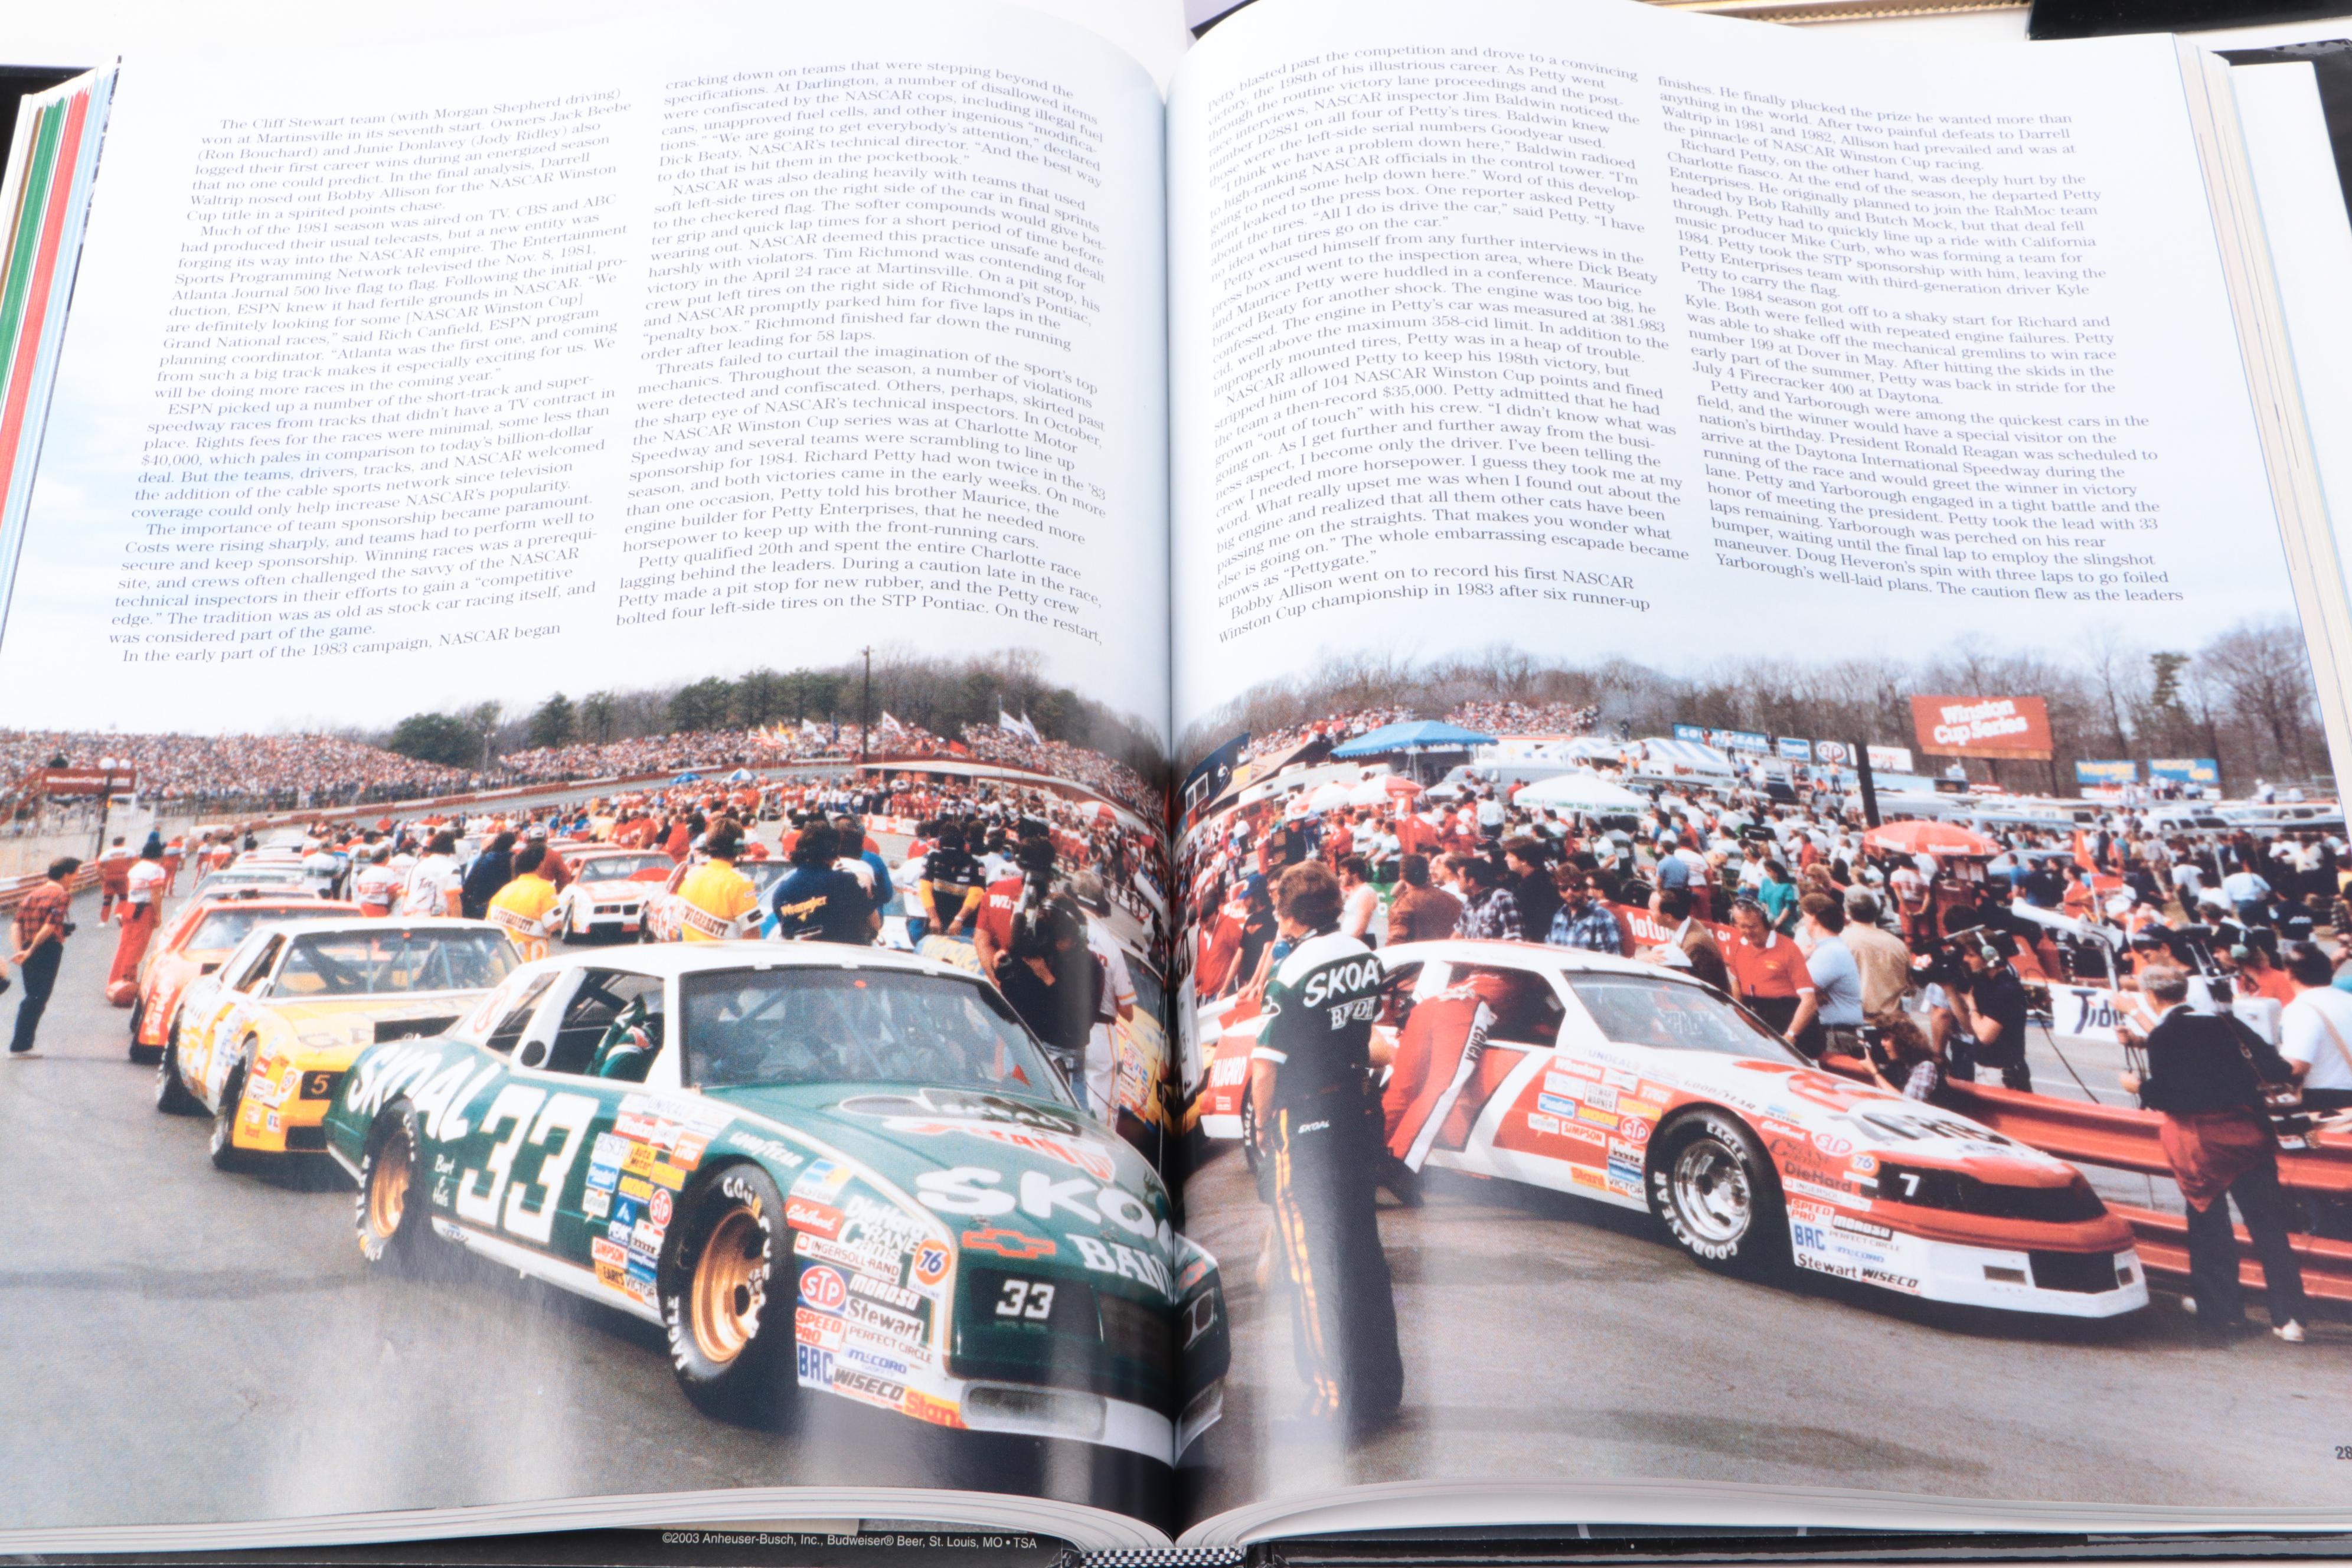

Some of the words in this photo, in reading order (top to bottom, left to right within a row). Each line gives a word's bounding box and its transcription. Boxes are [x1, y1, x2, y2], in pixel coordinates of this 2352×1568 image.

[1291, 55, 1319, 73] past
[1325, 51, 1349, 63] the
[1354, 44, 1445, 58] competition
[1451, 46, 1478, 57] and
[1482, 47, 1525, 60] drove
[1530, 53, 1544, 63] to
[1549, 57, 1557, 65] a
[1561, 60, 1638, 83] convincing
[219, 118, 249, 130] The
[251, 117, 286, 130] Cliff
[288, 115, 345, 129] Stewart
[350, 115, 386, 125] team
[390, 110, 428, 123] (with
[434, 107, 488, 119] Morgan
[493, 96, 561, 114] Shepherd
[565, 88, 620, 105] driving)
[1658, 76, 1715, 95] finishes.
[1720, 86, 1739, 99] He
[1743, 90, 1786, 108] finally
[1791, 99, 1847, 115] plucked
[1850, 106, 1873, 119] the
[1876, 111, 1912, 122] prize
[1916, 112, 1933, 123] he
[1938, 114, 1992, 125] wanted
[1996, 116, 2034, 125] more
[2039, 113, 2072, 124] than
[1716, 553, 1815, 579] Yarborough's
[1818, 571, 1883, 588] well-laid
[1887, 577, 1932, 593] plans.
[1936, 581, 1966, 595] The
[1971, 586, 2030, 599] caution
[2034, 587, 2067, 600] flew
[2073, 591, 2091, 601] as
[2095, 589, 2120, 601] the
[2125, 589, 2184, 602] leaders
[616, 608, 666, 626] bolted
[672, 606, 705, 619] four
[710, 598, 775, 615] left-side
[781, 596, 818, 609] tires
[823, 597, 844, 607] on
[850, 594, 876, 607] the
[881, 593, 917, 607] STP
[922, 594, 989, 613] Pontiac.
[995, 603, 1018, 619] On
[1024, 609, 1048, 625] the
[1053, 618, 1102, 645] restart,
[1219, 615, 1271, 643] Winston
[1276, 604, 1306, 619] Cup
[1311, 584, 1429, 610] championship
[1434, 583, 1450, 596] in
[1458, 583, 1494, 596] 1983
[1500, 584, 1538, 598] after
[1543, 587, 1567, 601] six
[1572, 592, 1650, 612] runner-up
[123, 649, 139, 662] In
[145, 649, 170, 662] the
[175, 648, 216, 663] early
[220, 648, 253, 663] part
[259, 646, 277, 658] of
[281, 645, 306, 658] the
[313, 642, 348, 656] 1983
[352, 638, 432, 654] campaign,
[439, 628, 509, 646] NASCAR
[514, 625, 560, 639] began
[1940, 700, 2015, 724] Winston
[1933, 724, 1971, 746] Cup
[1970, 716, 2028, 739] Series
[1303, 958, 1382, 1008] SKOA
[311, 1074, 331, 1095] 5
[1298, 1119, 1330, 1134] SKOAL
[1564, 1123, 1603, 1142] SIMPSON
[1623, 1120, 1647, 1139] STP
[1706, 1122, 1747, 1161] EAGLE
[456, 1083, 600, 1246] 33
[1784, 1161, 1853, 1193] DieHard
[1856, 1156, 1873, 1170] 76
[1608, 1178, 1645, 1195] VICTOR
[1899, 1172, 1920, 1197] 7
[652, 1194, 669, 1221] STP
[1791, 1210, 1817, 1223] PRO
[1792, 1199, 1831, 1216] SPEED
[1794, 1223, 1826, 1251] BRC
[594, 1240, 625, 1263] SIMPSON
[919, 1249, 943, 1274] 76
[1797, 1252, 1858, 1279] Stewart
[625, 1273, 655, 1298] VICTOR
[805, 1270, 841, 1302] STP
[1861, 1266, 1919, 1289] WISECO
[995, 1279, 1056, 1319] 33
[667, 1296, 689, 1370] EAGLE
[795, 1326, 822, 1344] PRO
[796, 1309, 843, 1334] SPEED
[848, 1298, 921, 1344] Stewart
[848, 1325, 897, 1349] PERFECT
[898, 1342, 933, 1364] CIRCLE
[798, 1344, 834, 1386] BRC
[833, 1367, 905, 1402] WISECO
[662, 1533, 700, 1544] ©2003
[702, 1533, 798, 1546] Anheuser-Busch,
[801, 1534, 824, 1547] Inc.,
[828, 1534, 894, 1547] Budweiser®
[897, 1536, 926, 1549] Beer,
[929, 1536, 944, 1547] St.
[947, 1536, 980, 1549] Louis,
[983, 1536, 1003, 1548] MO
[1014, 1537, 1038, 1550] TSA
